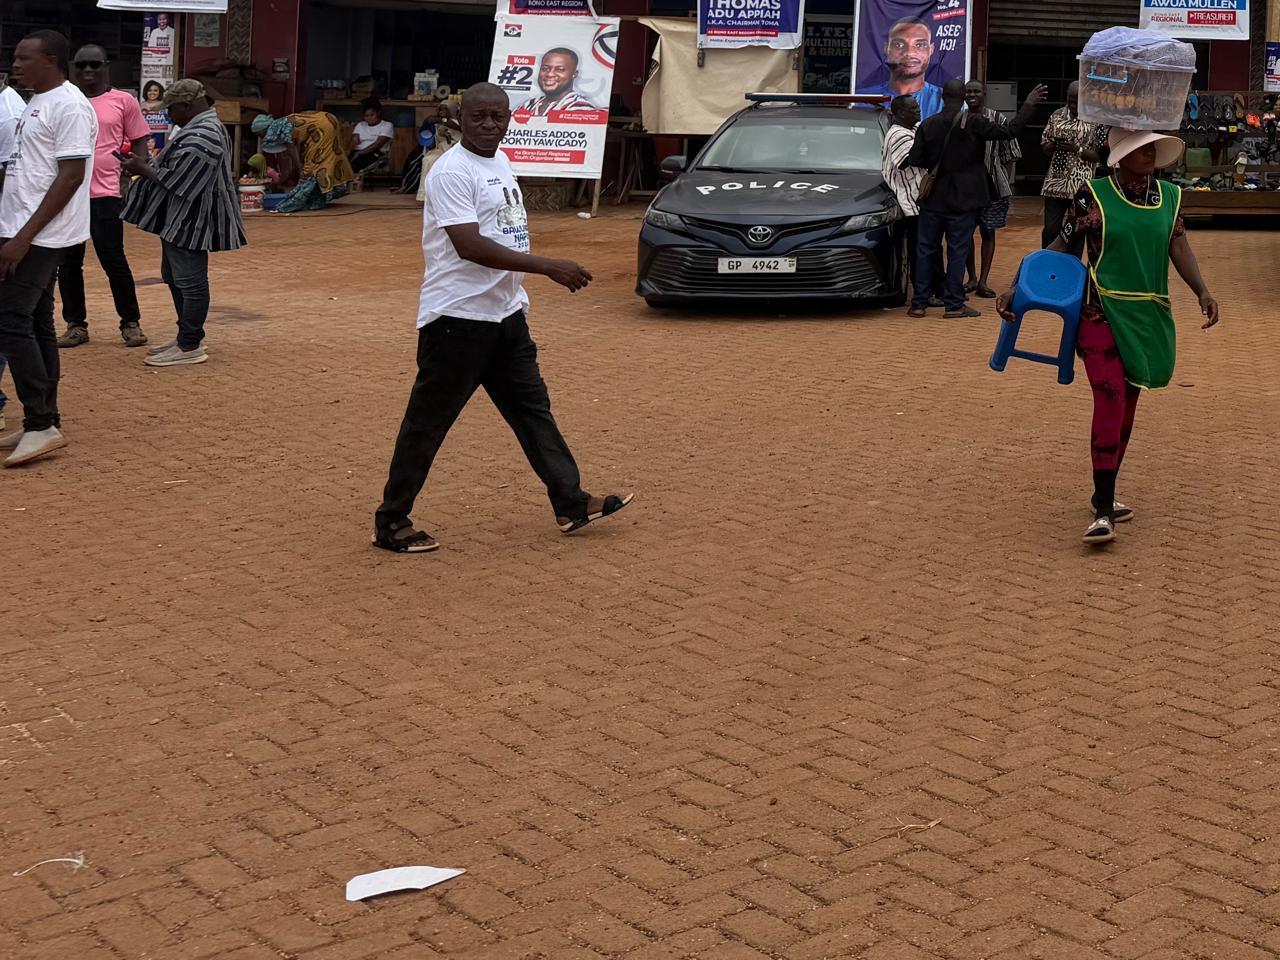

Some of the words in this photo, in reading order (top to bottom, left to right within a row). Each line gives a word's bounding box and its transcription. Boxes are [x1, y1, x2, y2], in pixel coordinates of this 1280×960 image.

[1189, 0, 1237, 10] MULLEN
[741, 10, 781, 20] APPIAH
[1151, 16, 1184, 24] REGIONAL
[1194, 12, 1233, 22] TREASURER
[497, 66, 534, 88] #2
[556, 139, 587, 149] (CADY)
[696, 181, 840, 195] POLICE
[728, 260, 742, 270] GP
[752, 260, 779, 270] 4942
